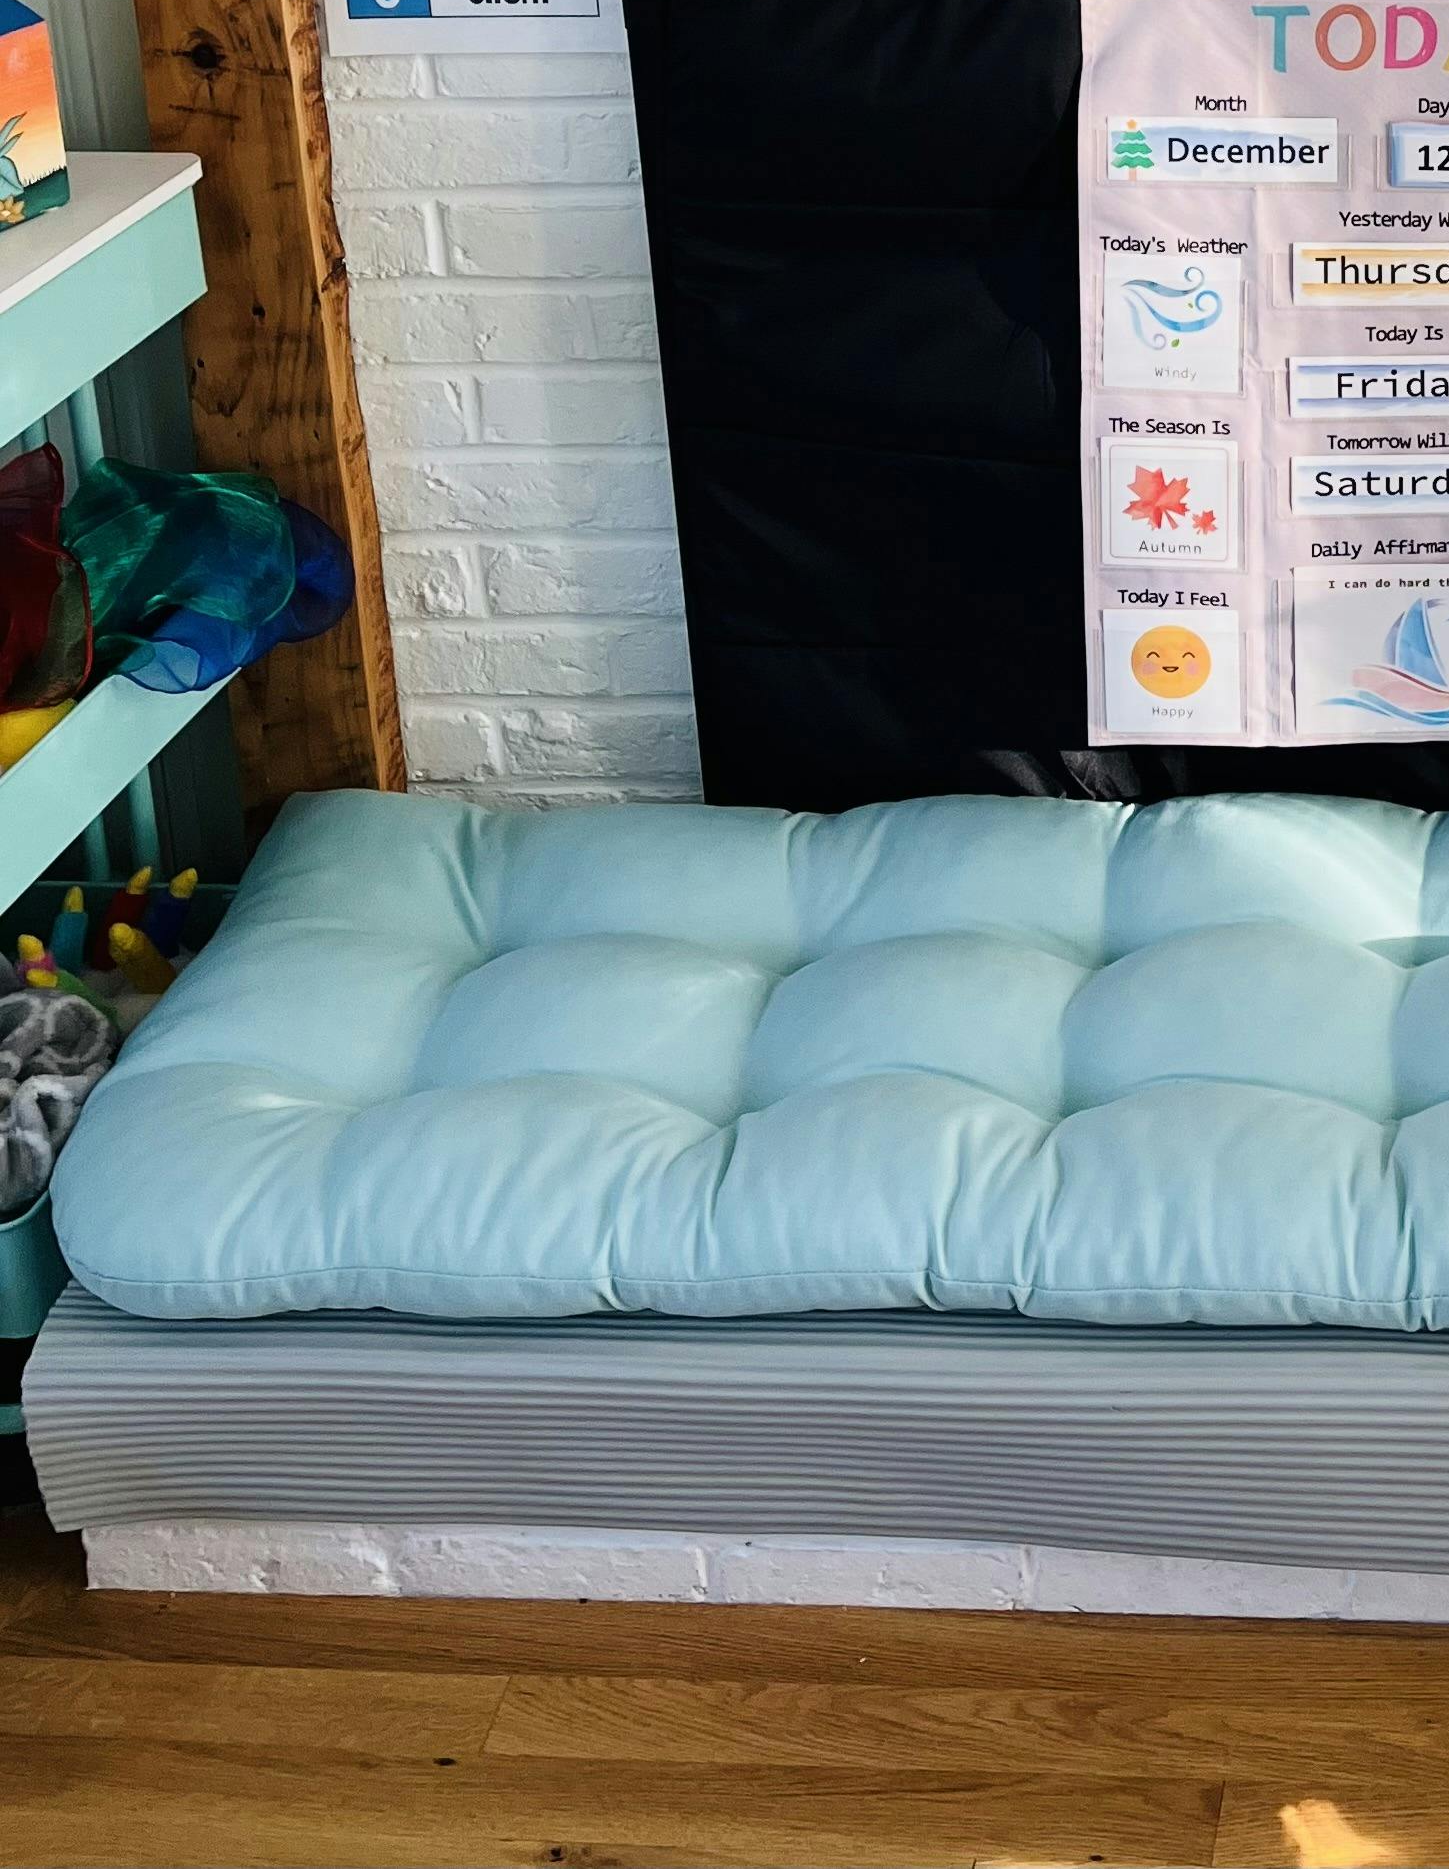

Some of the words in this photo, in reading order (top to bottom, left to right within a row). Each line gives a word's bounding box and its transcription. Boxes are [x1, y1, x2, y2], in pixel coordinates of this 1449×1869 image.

[1194, 94, 1247, 113] Month
[1167, 136, 1331, 167] December
[1339, 211, 1432, 232] Yesterday
[1100, 236, 1166, 257] Today's
[1177, 237, 1248, 255] Weather
[1365, 326, 1418, 345] Today
[1424, 325, 1444, 342] Is
[1154, 366, 1198, 382] Windy
[1108, 418, 1139, 434] The
[1145, 418, 1206, 435] Season
[1212, 419, 1231, 435] Is
[1327, 434, 1412, 451] Tomorrow
[1138, 539, 1202, 556] Autumn
[1311, 539, 1362, 560] Daily
[1328, 579, 1336, 589] I
[1344, 580, 1368, 589] can
[1375, 578, 1391, 588] do
[1399, 577, 1431, 589] hard
[1118, 588, 1169, 608] Today
[1174, 590, 1185, 606] I
[1190, 590, 1230, 608] Feel
[1152, 705, 1194, 720] Happy
